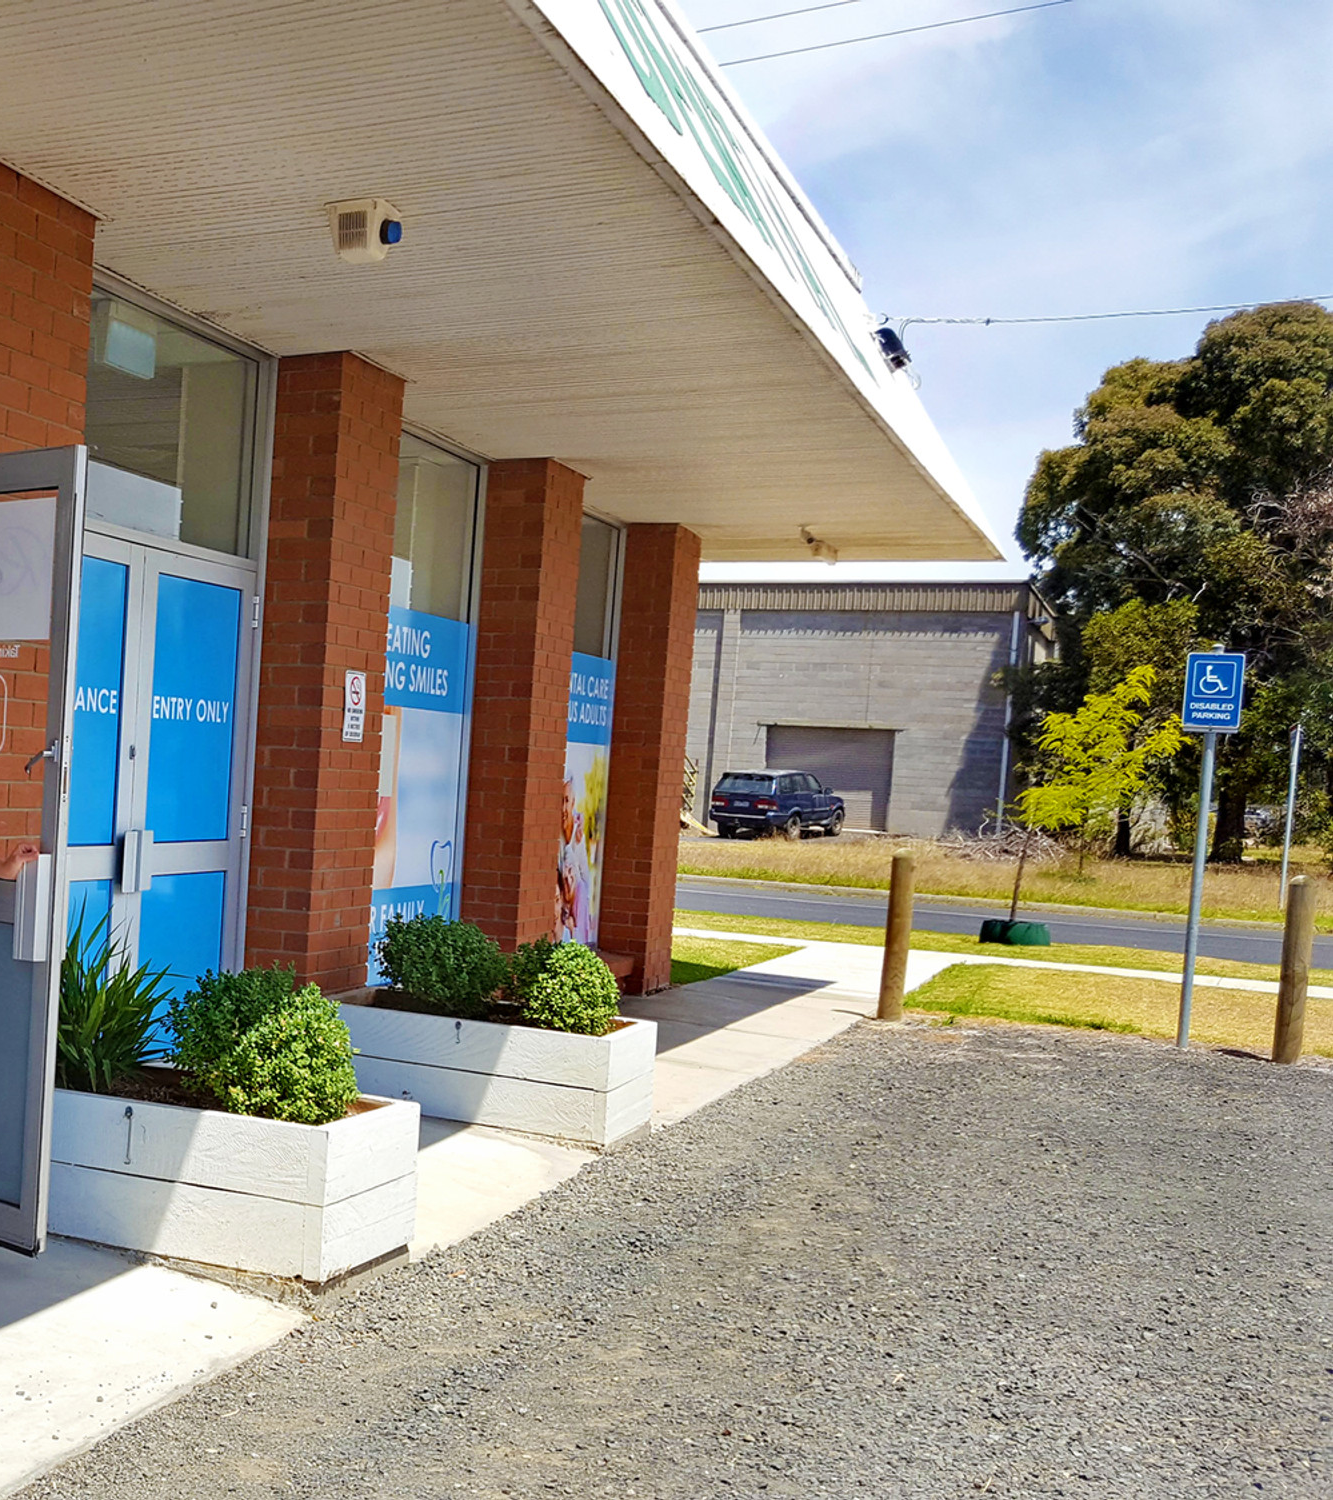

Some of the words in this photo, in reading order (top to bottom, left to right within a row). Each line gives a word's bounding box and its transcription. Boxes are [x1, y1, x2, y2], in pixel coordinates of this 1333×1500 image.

[409, 664, 449, 696] SMILES
[587, 676, 610, 700] CARE
[74, 686, 117, 715] ANCE
[153, 695, 193, 721] ENTRY
[196, 699, 229, 724] ONLY
[1189, 702, 1235, 711] DISABLED
[578, 703, 608, 727] ADULTS
[1191, 711, 1232, 720] PARKING
